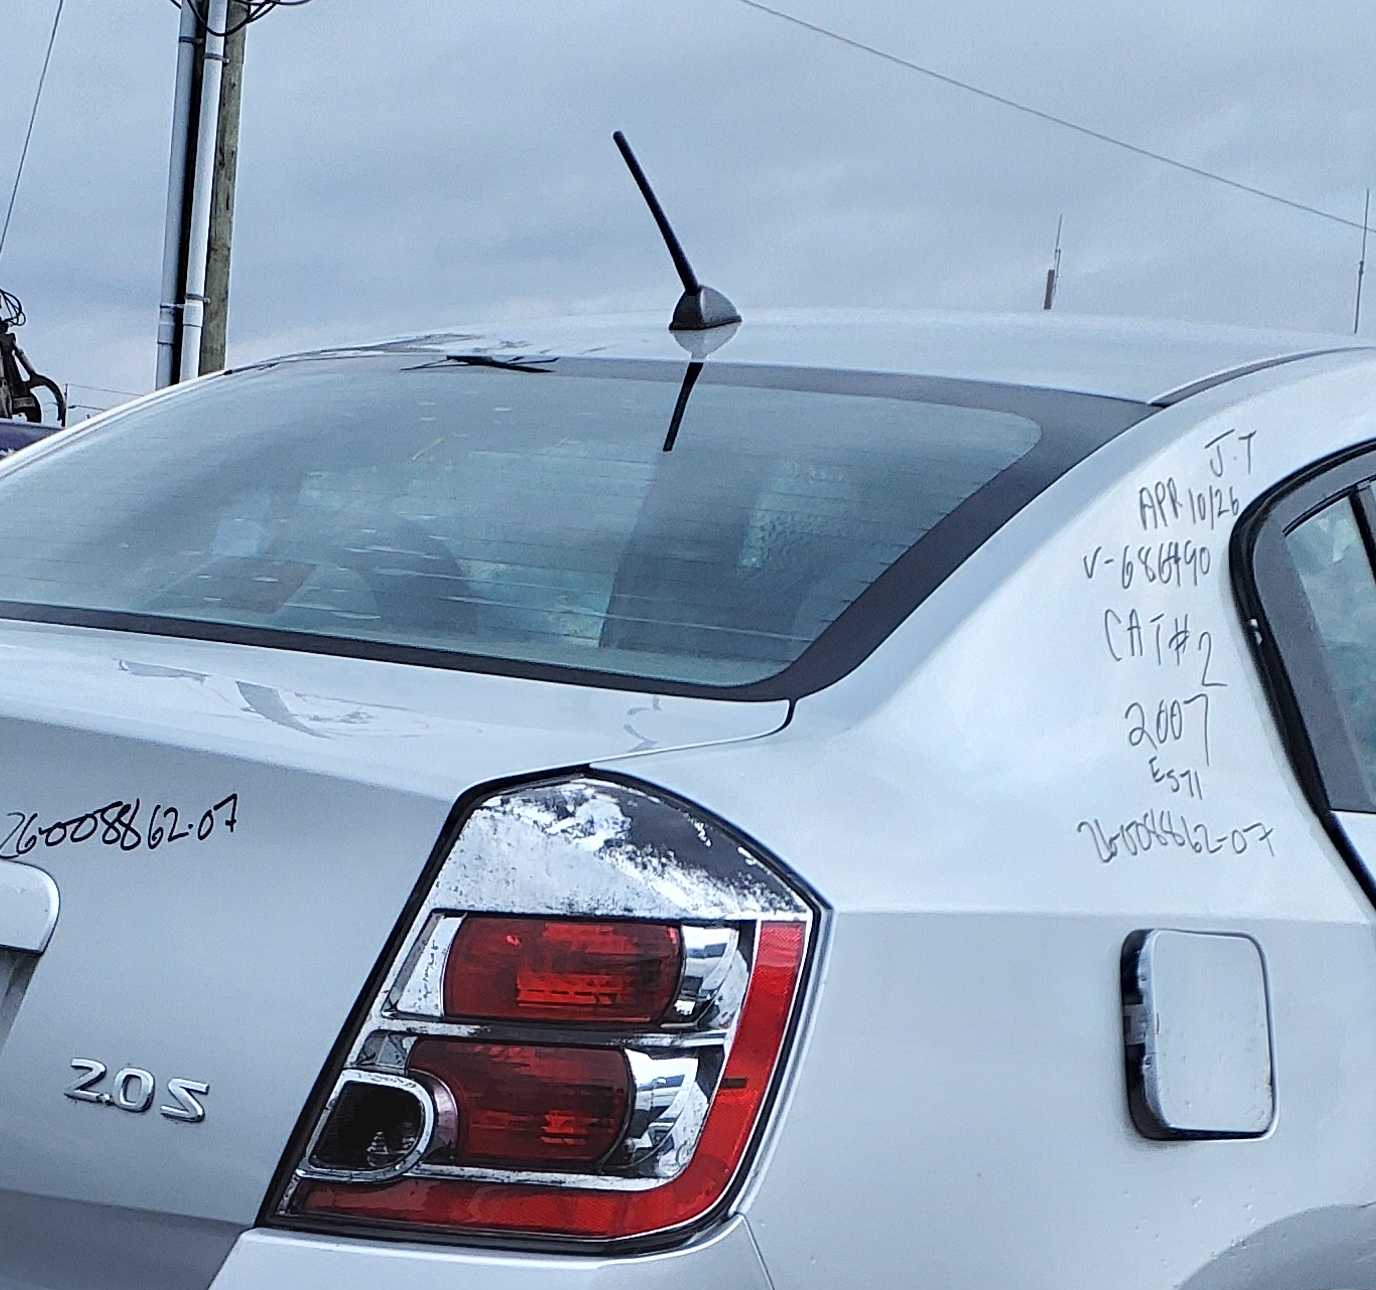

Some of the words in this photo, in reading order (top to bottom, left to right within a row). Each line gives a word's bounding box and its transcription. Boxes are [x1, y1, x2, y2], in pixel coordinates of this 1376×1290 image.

[1125, 694, 1210, 767] 2007
[64, 1057, 156, 1113] 2.0
[160, 1077, 210, 1123] S
